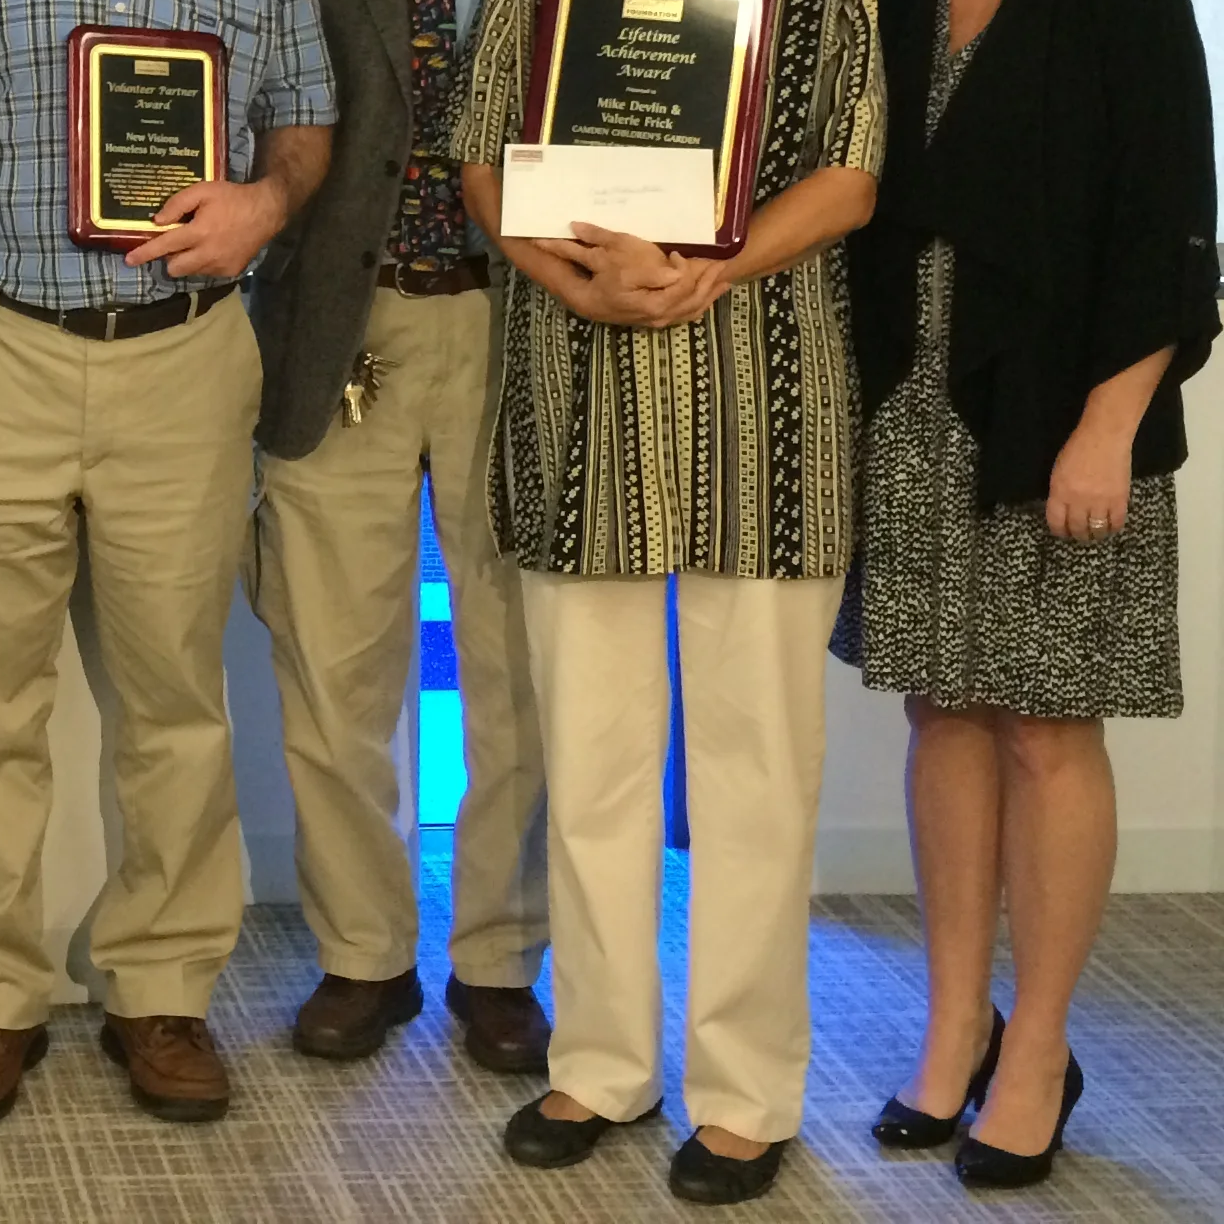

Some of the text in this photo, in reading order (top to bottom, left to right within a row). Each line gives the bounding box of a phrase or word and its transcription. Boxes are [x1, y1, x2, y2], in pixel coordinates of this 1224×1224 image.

[626, 9, 678, 18] FOUNDATION
[617, 27, 680, 45] Lifetime
[597, 44, 697, 65] Achievement
[616, 64, 676, 81] Award
[107, 81, 199, 97] Volunteer Partner
[134, 99, 173, 110] Award
[597, 97, 682, 116] Mike Devlin &
[601, 112, 674, 130] Valerie Frick
[126, 132, 179, 144] New Visions
[572, 125, 609, 136] CAMDEN
[611, 128, 661, 141] CHILDREN'S
[664, 132, 701, 144] GARDEN
[105, 143, 200, 157] Homeless Day Shelter
